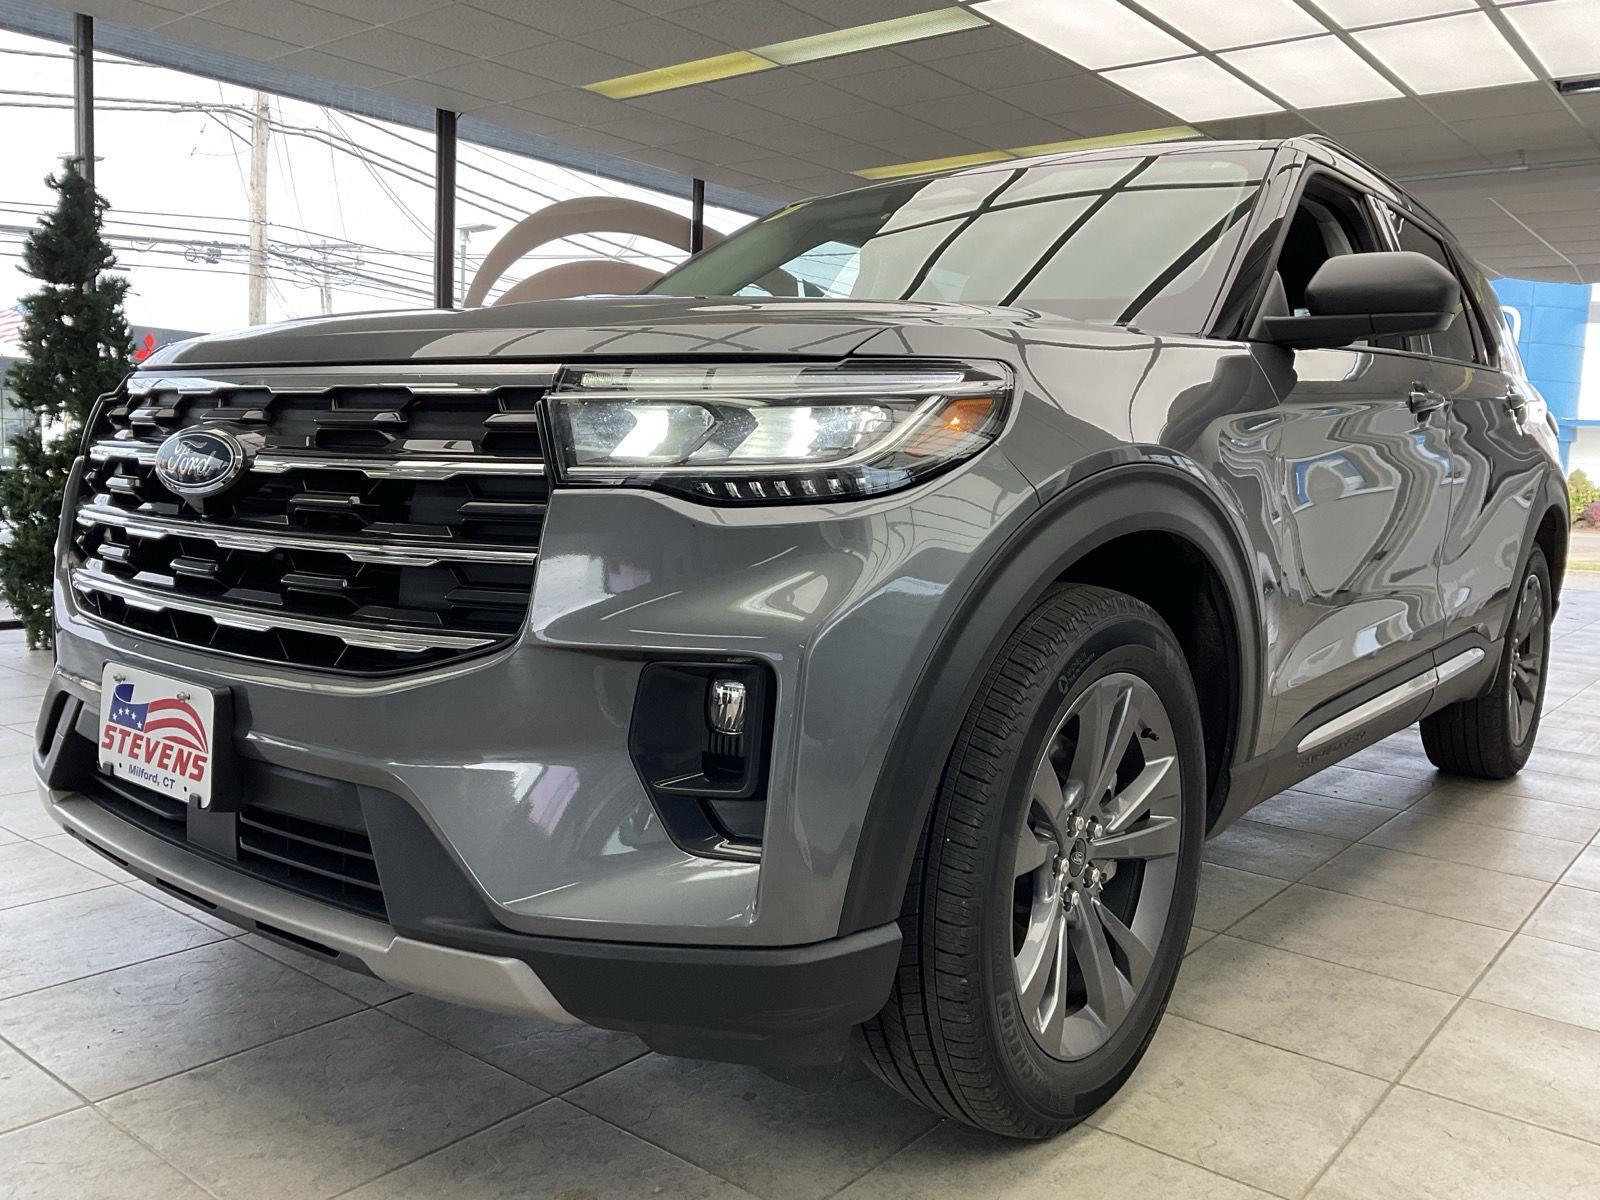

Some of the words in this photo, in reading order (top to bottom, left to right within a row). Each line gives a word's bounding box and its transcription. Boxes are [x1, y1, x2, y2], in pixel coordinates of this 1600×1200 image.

[165, 440, 228, 482] Ford
[101, 724, 208, 782] STEVENS
[128, 764, 160, 786] Milford,
[162, 776, 176, 789] CT
[998, 994, 1046, 1087] CHELIN
